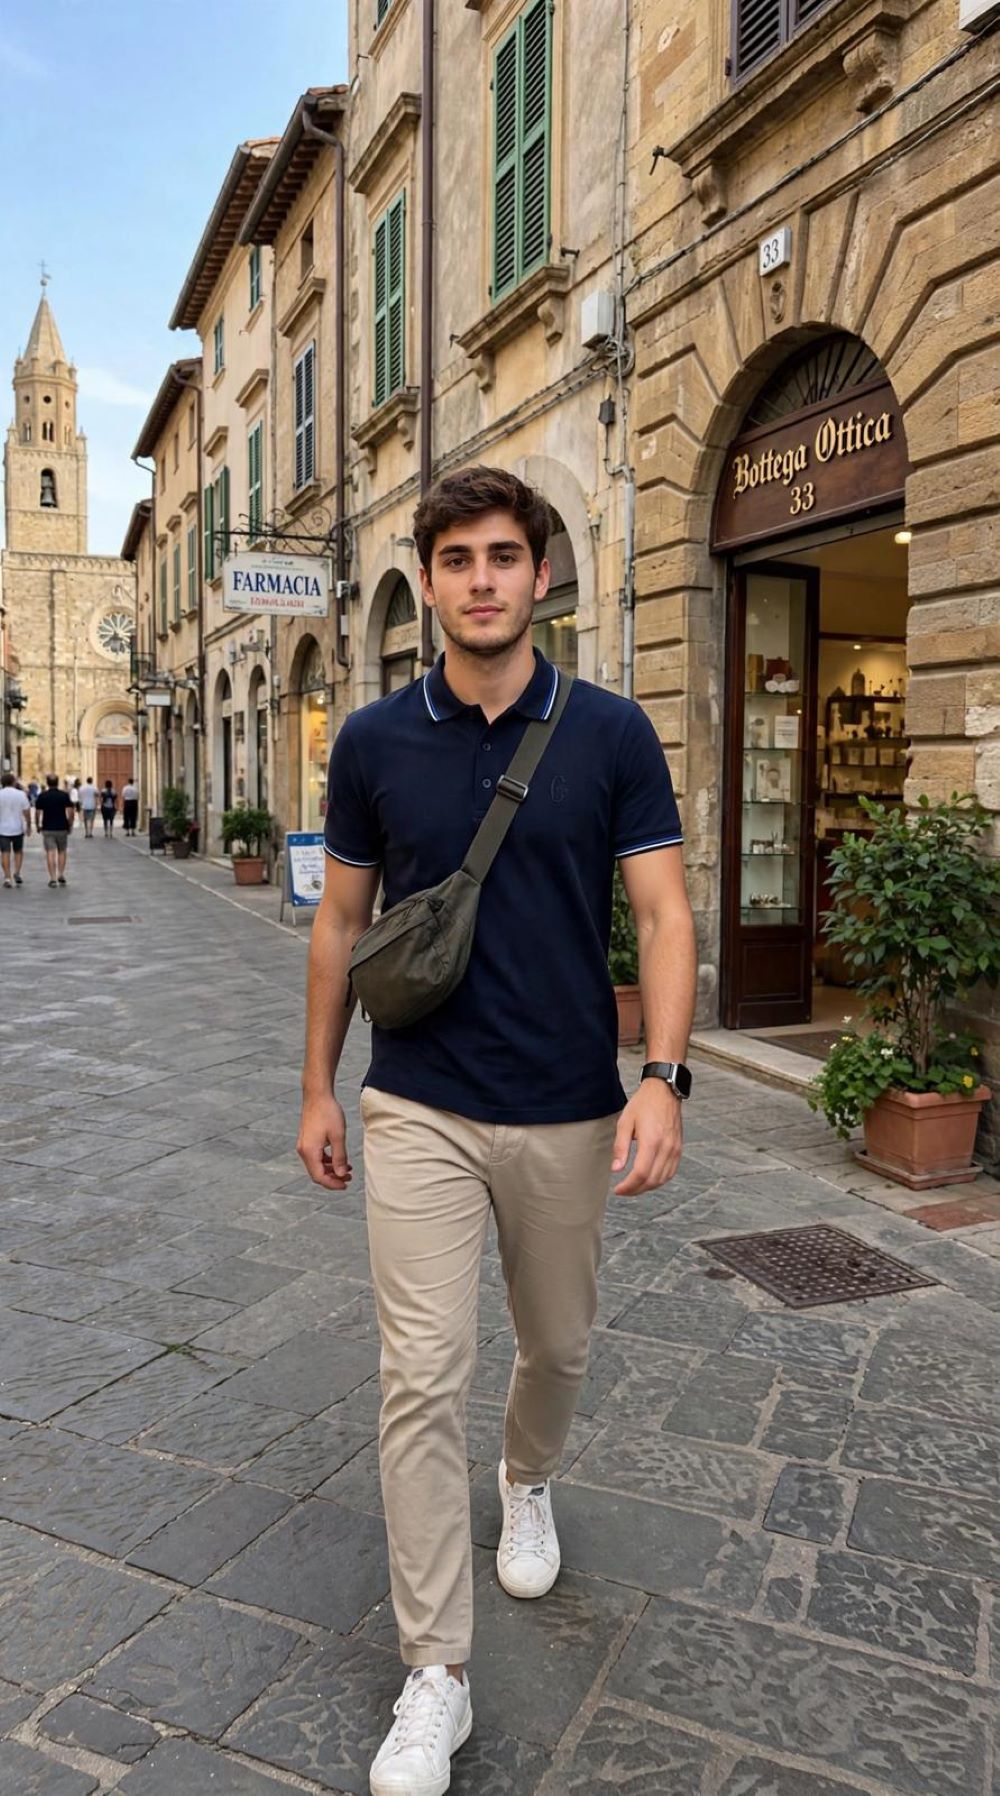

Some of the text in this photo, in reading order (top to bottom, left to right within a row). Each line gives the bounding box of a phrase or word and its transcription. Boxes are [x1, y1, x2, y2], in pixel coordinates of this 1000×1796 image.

[763, 238, 779, 268] 33
[733, 411, 892, 499] Bottega Ottica
[789, 481, 815, 515] 33
[233, 571, 321, 597] FARMACIA
